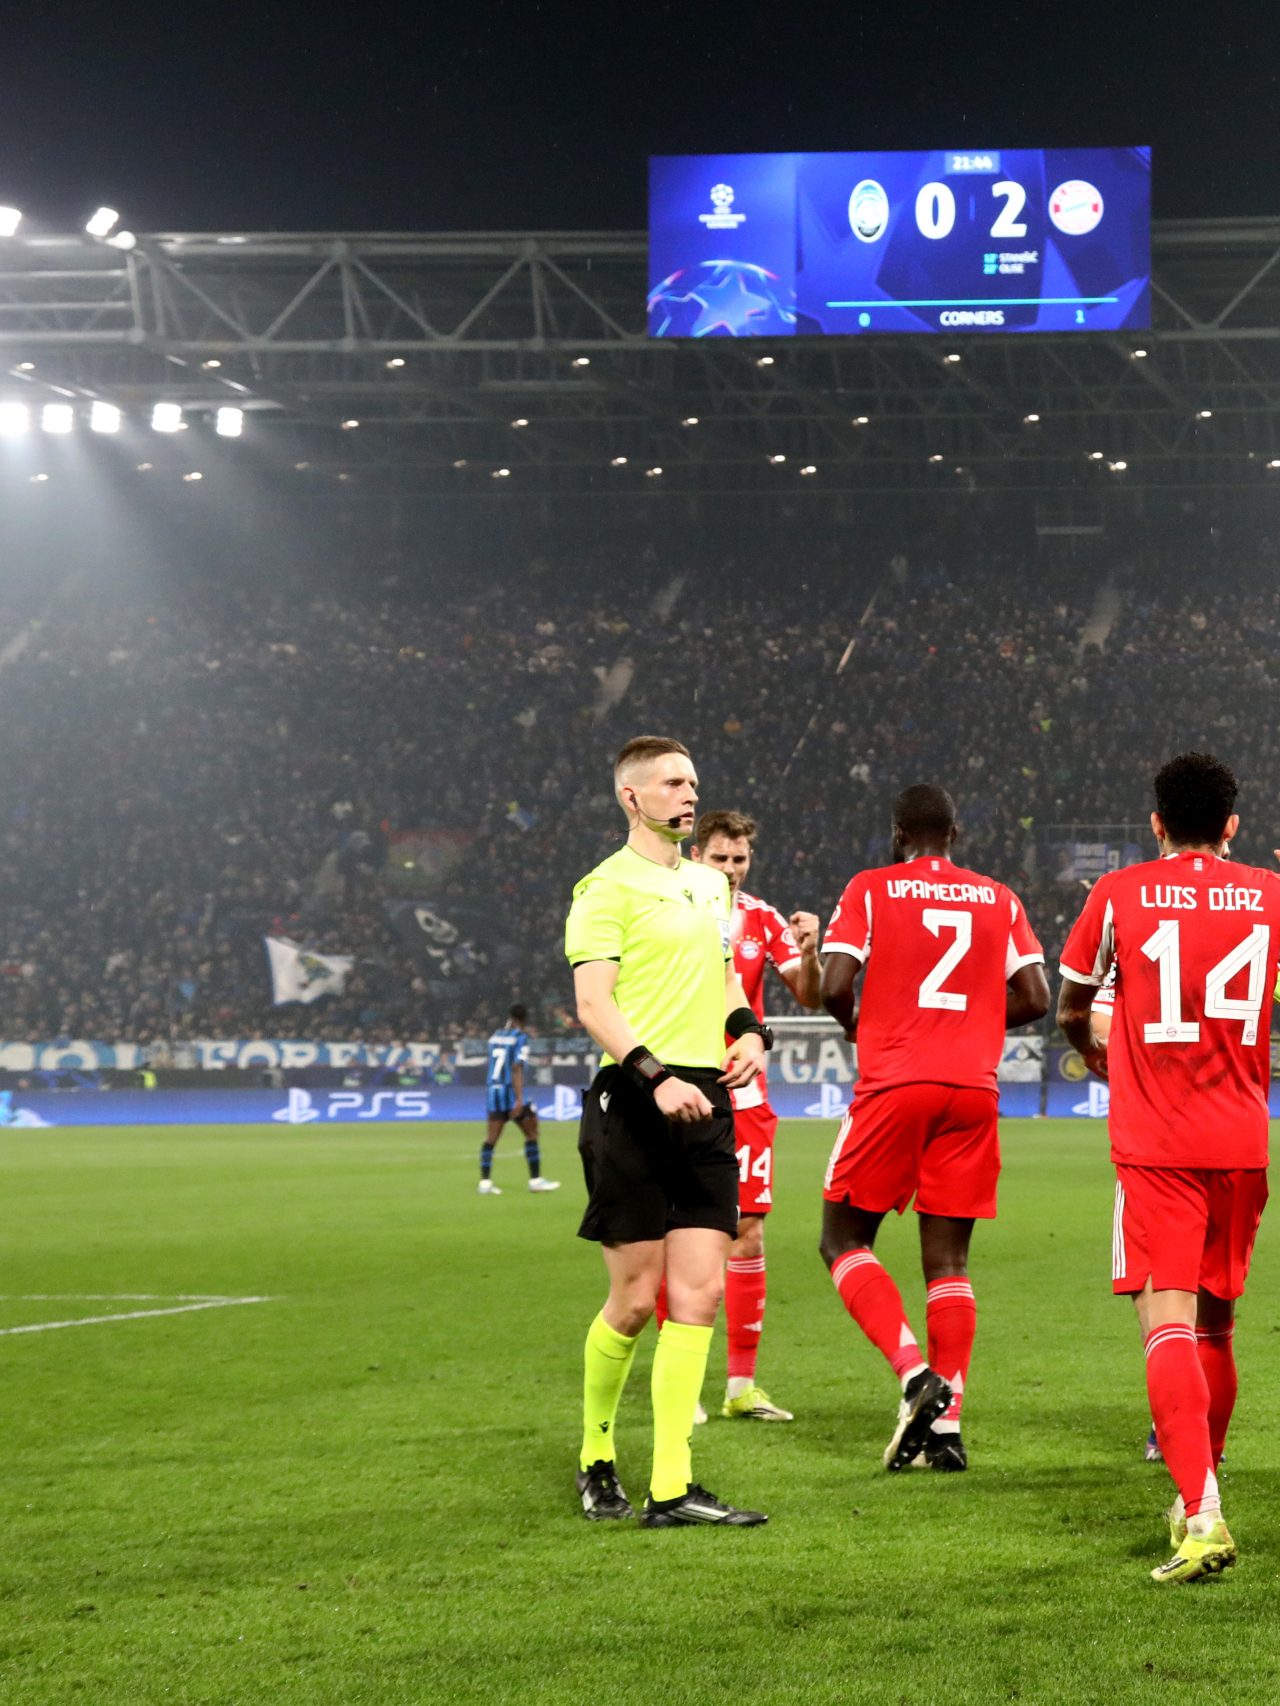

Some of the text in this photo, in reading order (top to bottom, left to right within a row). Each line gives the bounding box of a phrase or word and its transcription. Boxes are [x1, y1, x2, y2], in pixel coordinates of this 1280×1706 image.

[915, 181, 1027, 240] 0 2
[858, 309, 1085, 328] 0 CORNERS 1
[887, 879, 996, 905] UPAMECANO
[1141, 883, 1264, 912] LUIS DÍAZ
[918, 908, 972, 1011] 2
[1140, 919, 1270, 1047] 14
[492, 1048, 506, 1081] 7
[328, 1091, 431, 1118] PS5
